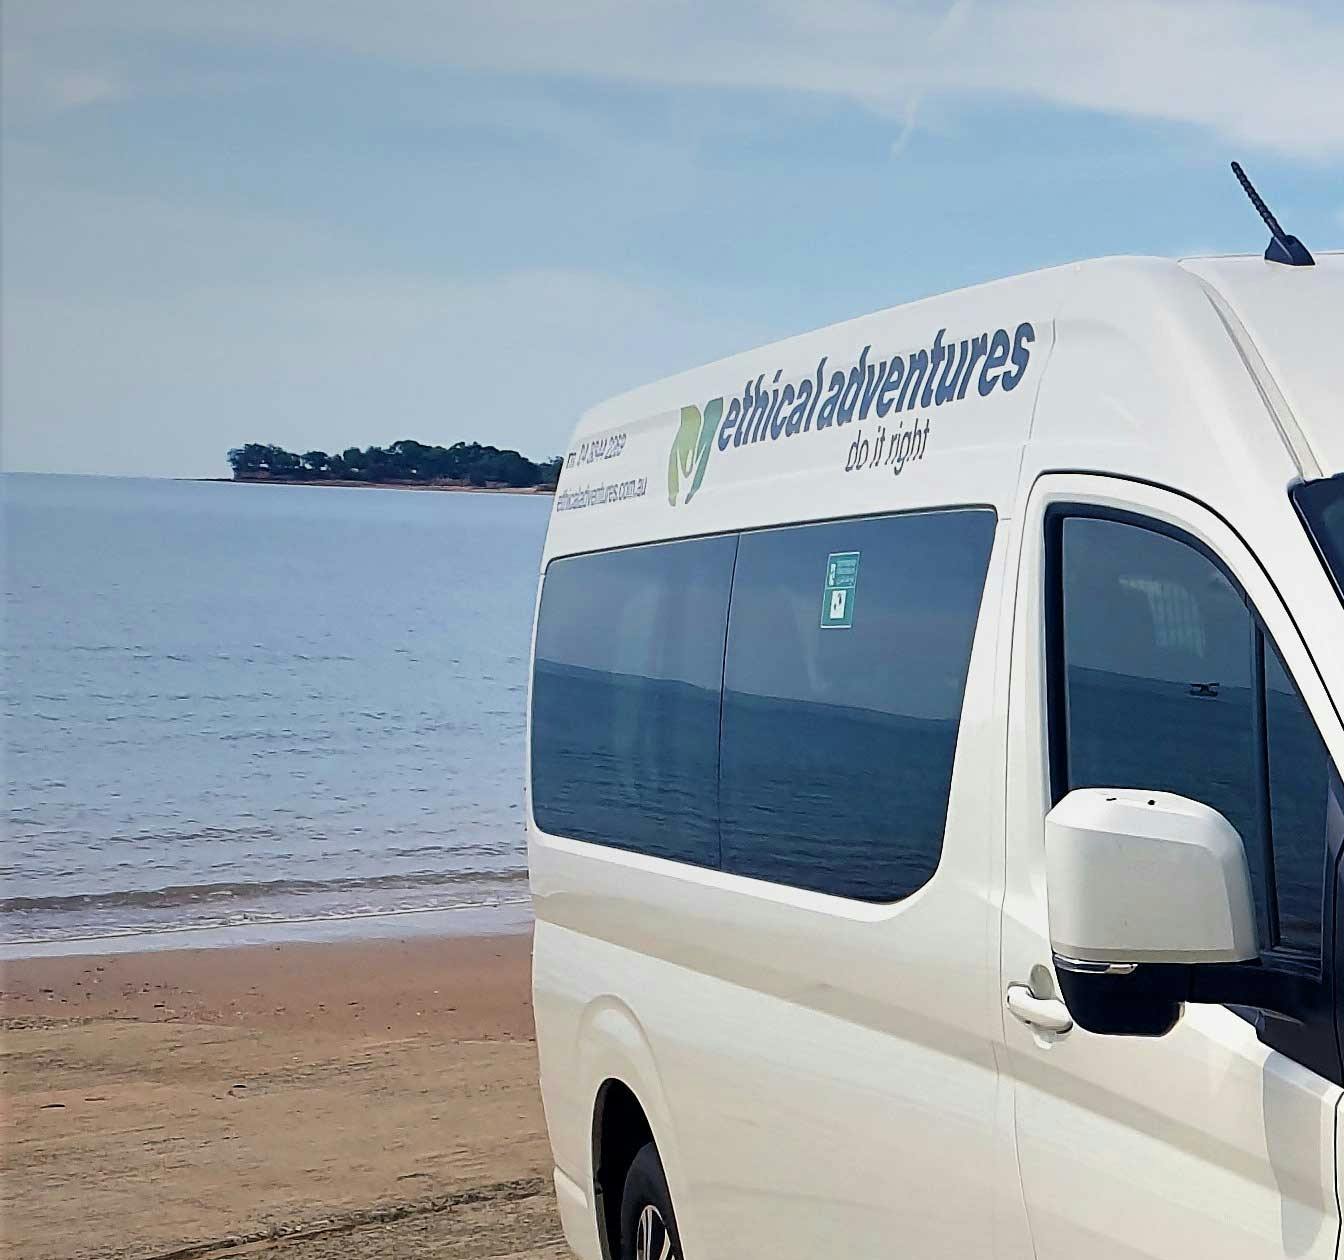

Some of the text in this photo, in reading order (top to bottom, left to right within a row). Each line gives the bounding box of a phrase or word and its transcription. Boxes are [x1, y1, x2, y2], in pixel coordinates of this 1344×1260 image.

[717, 322, 1036, 452] ethical adventures
[845, 418, 930, 476] do it right
